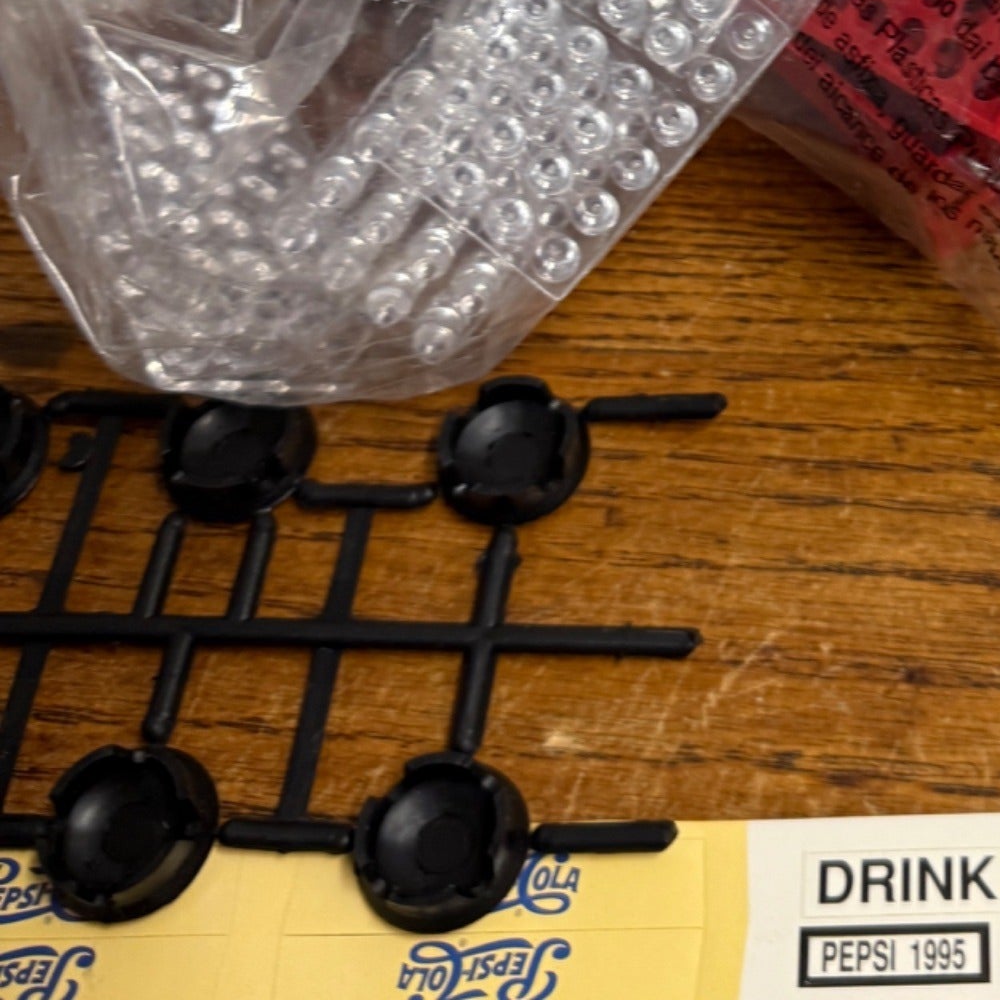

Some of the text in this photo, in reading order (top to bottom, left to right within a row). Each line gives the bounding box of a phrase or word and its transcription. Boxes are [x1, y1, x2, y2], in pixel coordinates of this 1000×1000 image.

[817, 854, 999, 905] DRINK
[821, 937, 966, 973] PEPSI 1995
